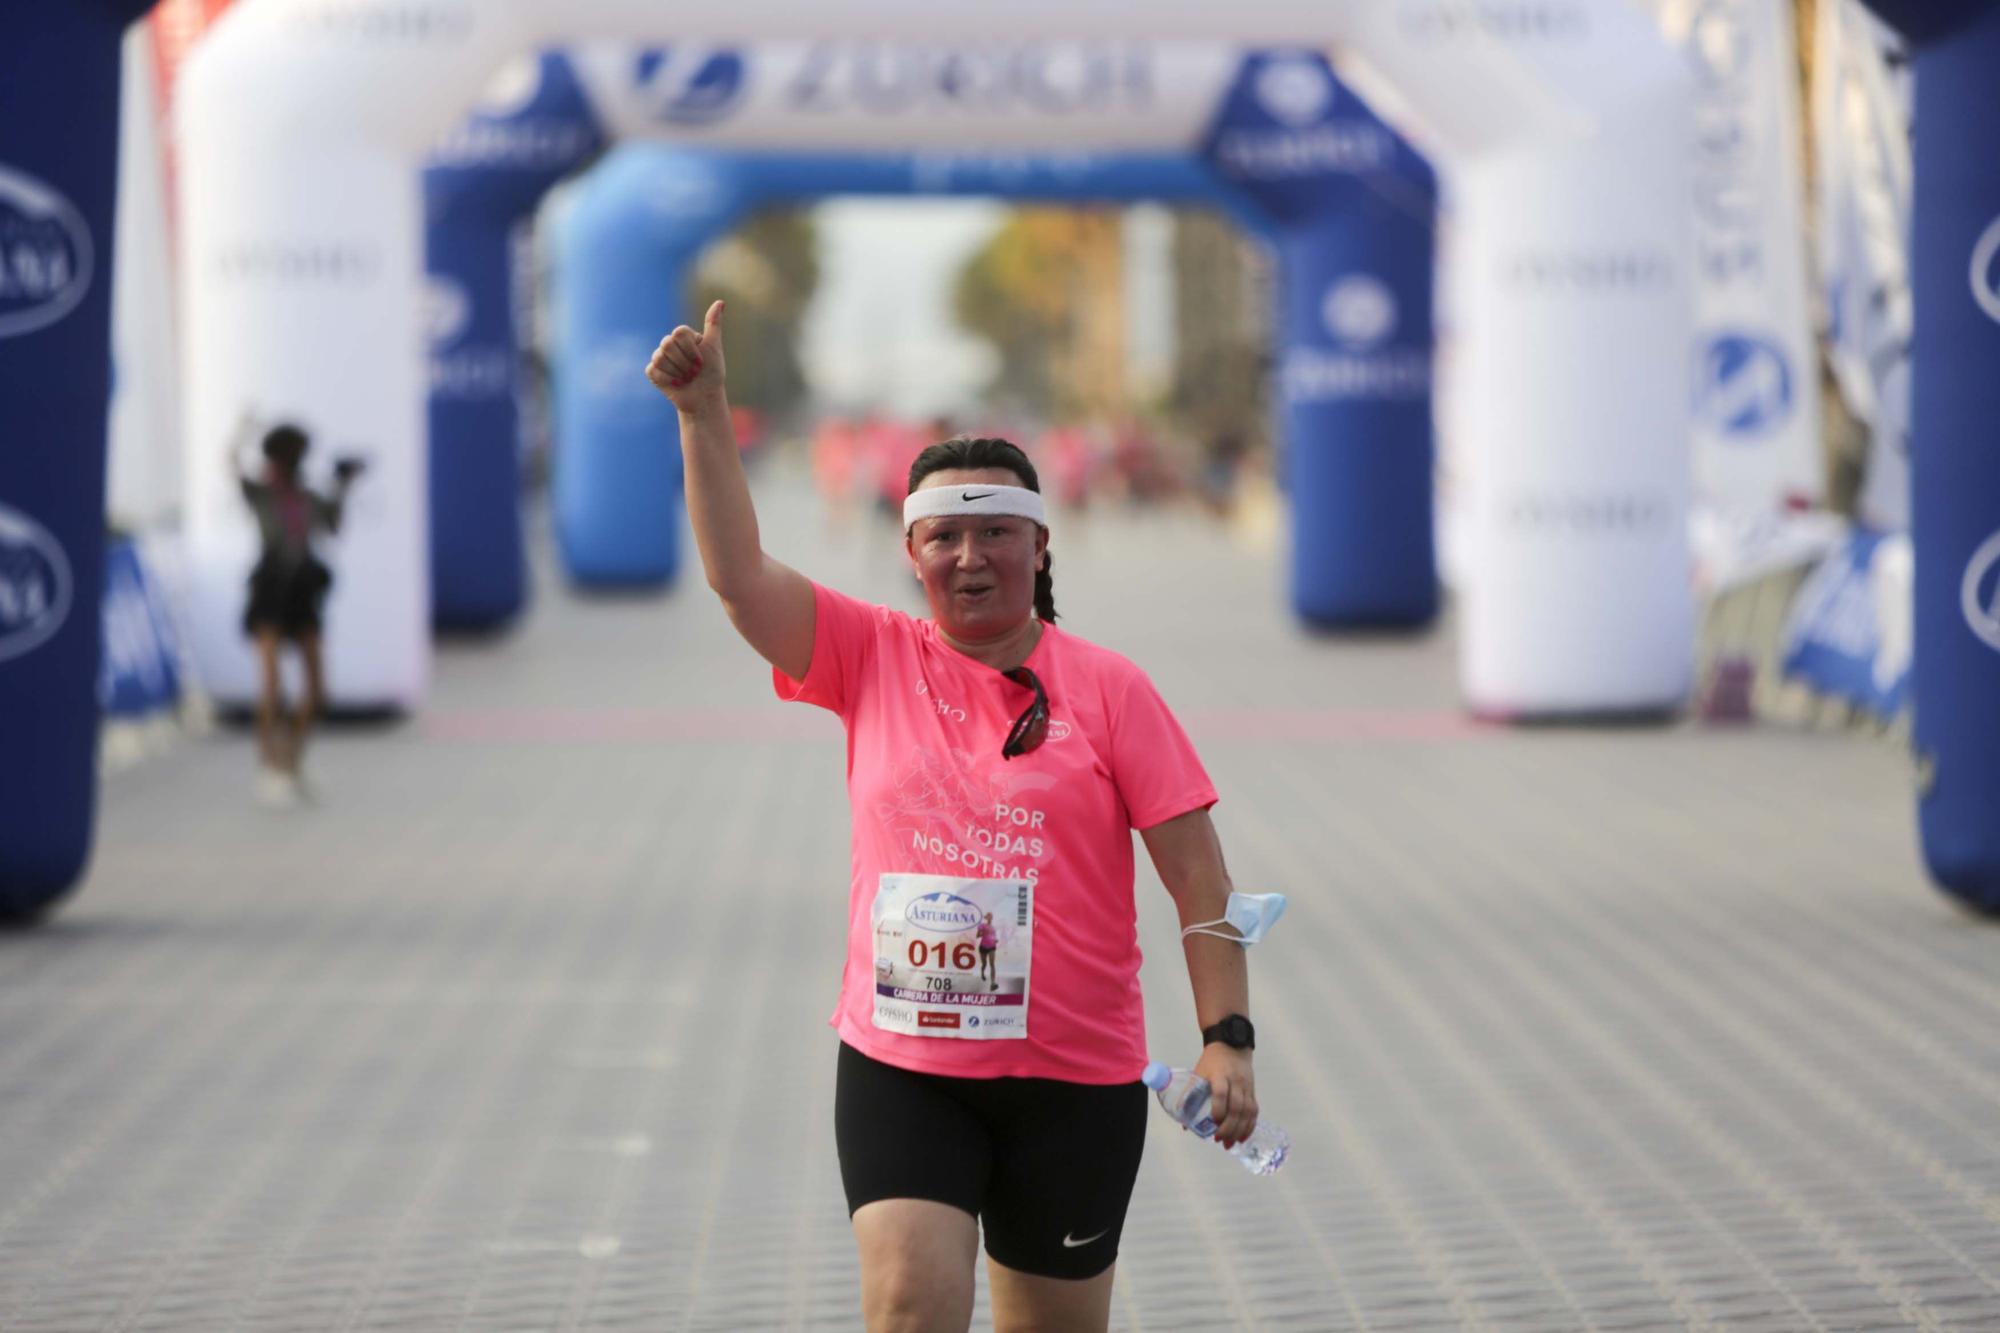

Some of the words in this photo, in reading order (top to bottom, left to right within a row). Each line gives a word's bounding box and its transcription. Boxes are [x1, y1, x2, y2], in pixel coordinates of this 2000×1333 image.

[995, 803, 1045, 829] POR
[913, 831, 1039, 886] NOSOTRAS
[910, 905, 976, 923] ASTURIANA
[908, 939, 976, 970] 016
[926, 976, 952, 991] 708
[893, 987, 928, 1002] CARRERA
[930, 992, 945, 1004] DE
[945, 993, 960, 1004] LA
[961, 993, 997, 1005] MUJER
